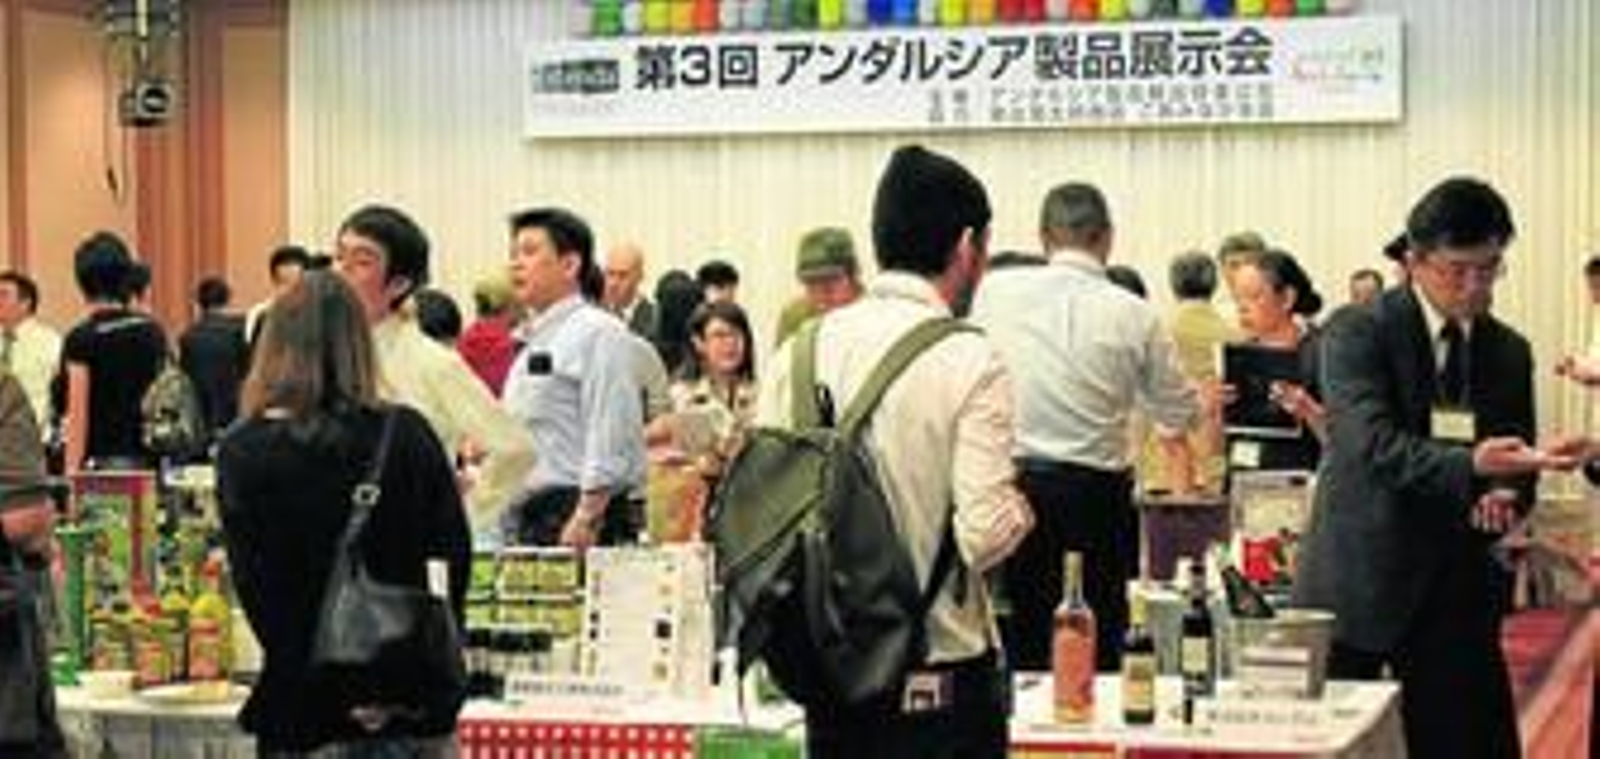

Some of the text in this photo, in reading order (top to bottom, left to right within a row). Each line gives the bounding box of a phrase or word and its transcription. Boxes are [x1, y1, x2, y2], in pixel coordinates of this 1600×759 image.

[635, 44, 759, 90] 第3回
[775, 27, 1274, 84] アンダルシア製品展示会
